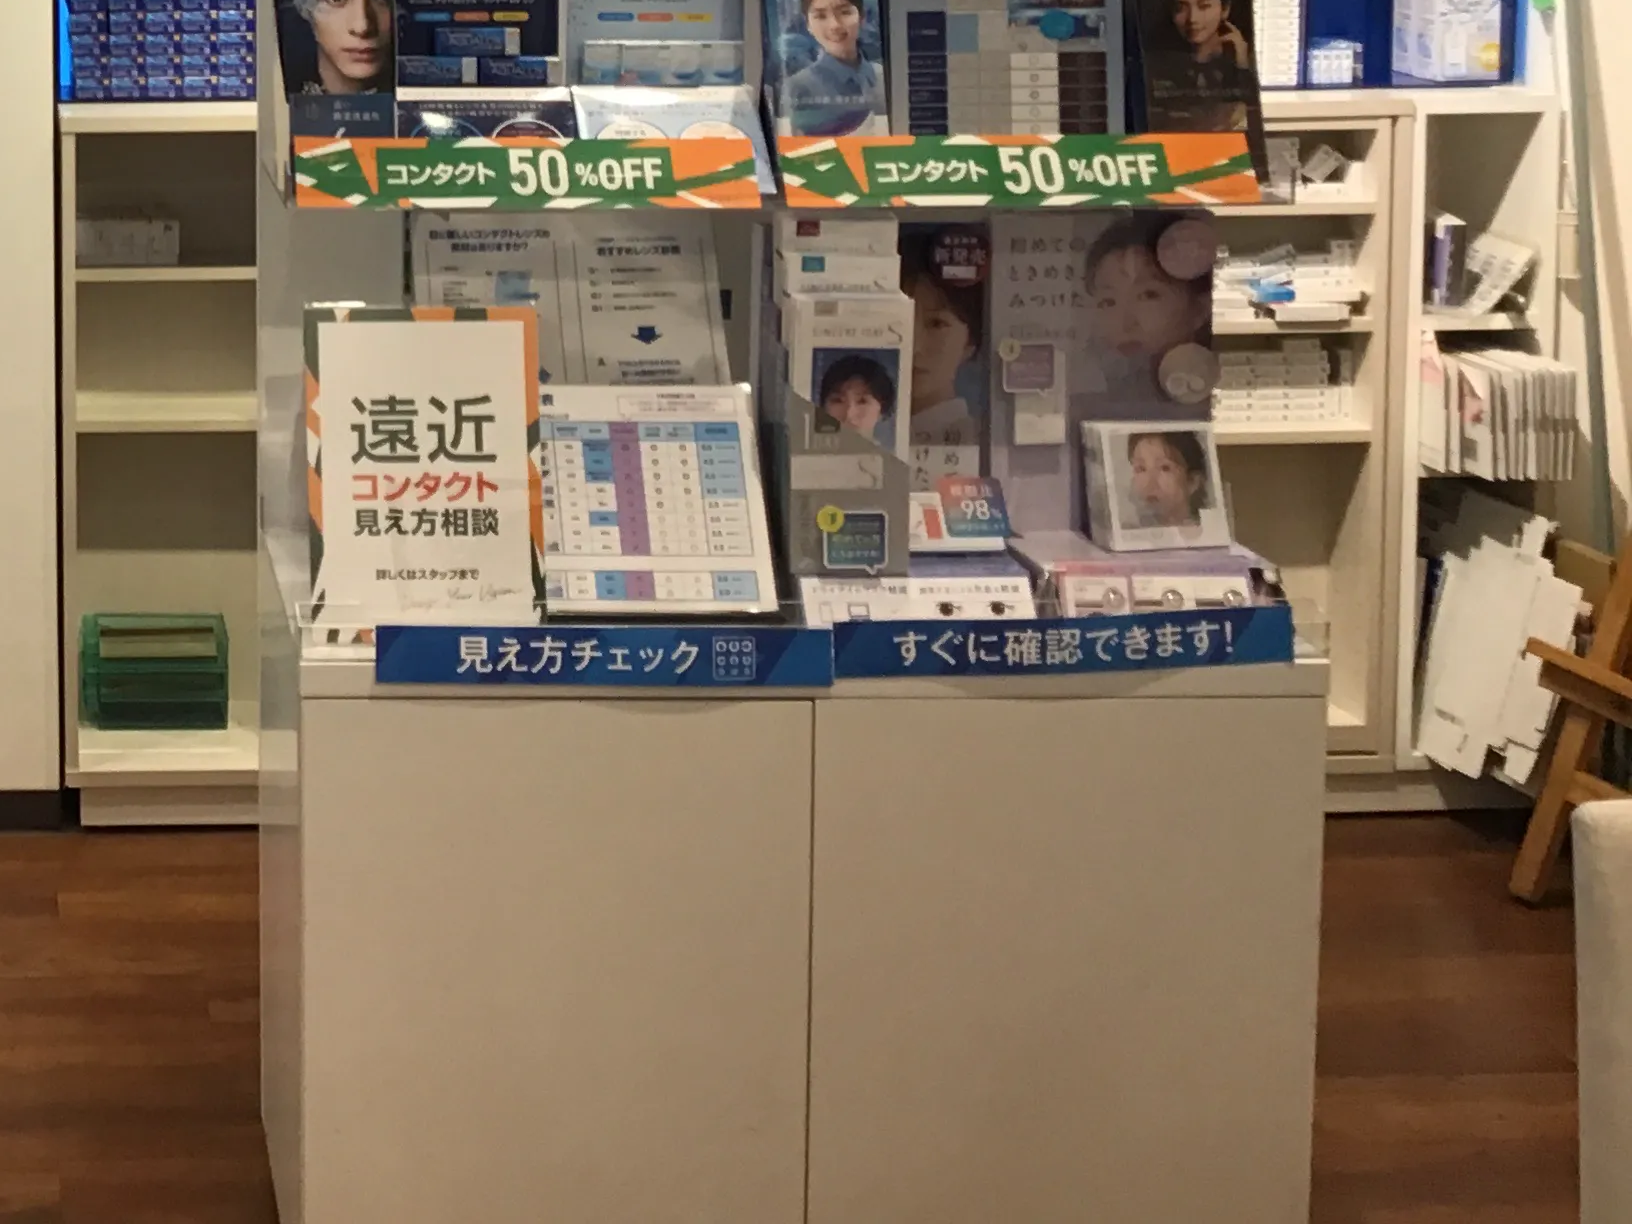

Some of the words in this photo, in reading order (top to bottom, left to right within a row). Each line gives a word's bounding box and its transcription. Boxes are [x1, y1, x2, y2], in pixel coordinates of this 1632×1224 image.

[386, 161, 496, 186] コンタクト
[874, 160, 989, 183] コンタクト
[350, 393, 498, 465] 遠近
[351, 470, 499, 503] コンタクト
[352, 508, 500, 537] 見え方相談
[456, 634, 700, 675] 見え方チェック
[893, 619, 1236, 667] すぐに確認できます!
